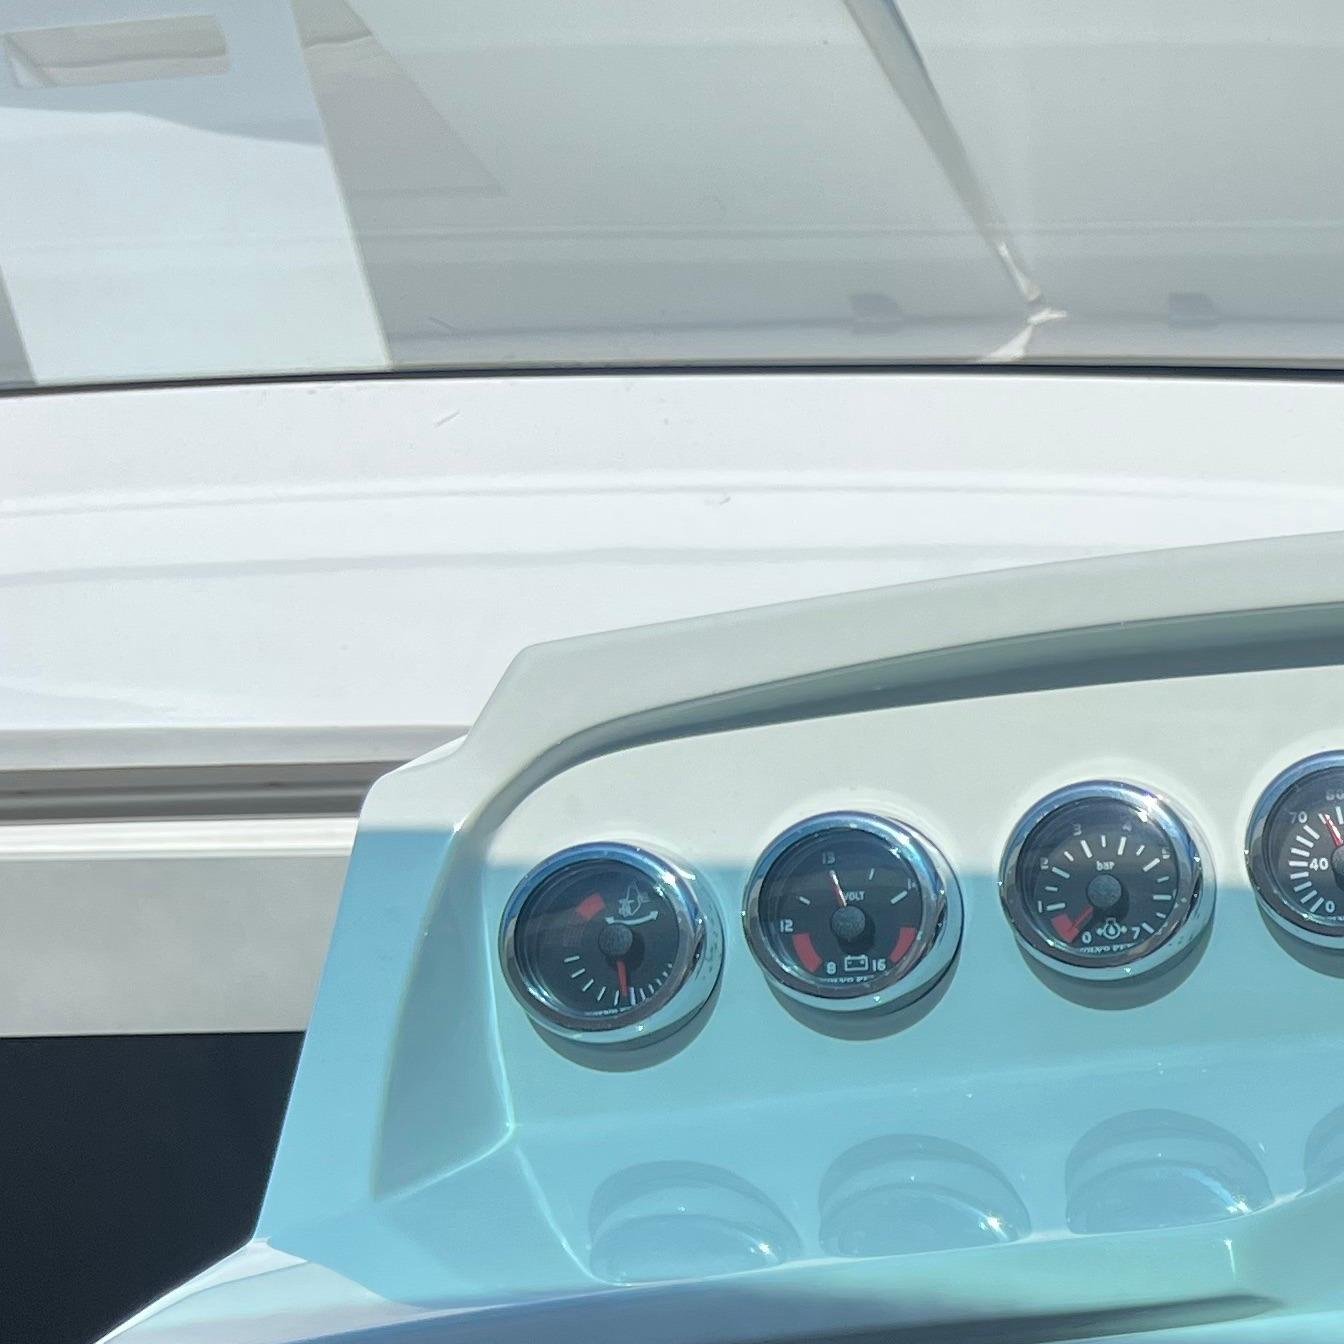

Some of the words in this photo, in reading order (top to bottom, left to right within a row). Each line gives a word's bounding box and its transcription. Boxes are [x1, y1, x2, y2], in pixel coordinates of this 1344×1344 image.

[1096, 861, 1115, 871] bar
[1310, 858, 1328, 871] 40
[843, 892, 865, 900] VOLT
[1325, 901, 1335, 913] 0
[780, 920, 793, 932] 12
[1082, 931, 1092, 943] 0
[1132, 927, 1140, 939] 7
[827, 963, 836, 974] 8
[872, 960, 886, 971] 16
